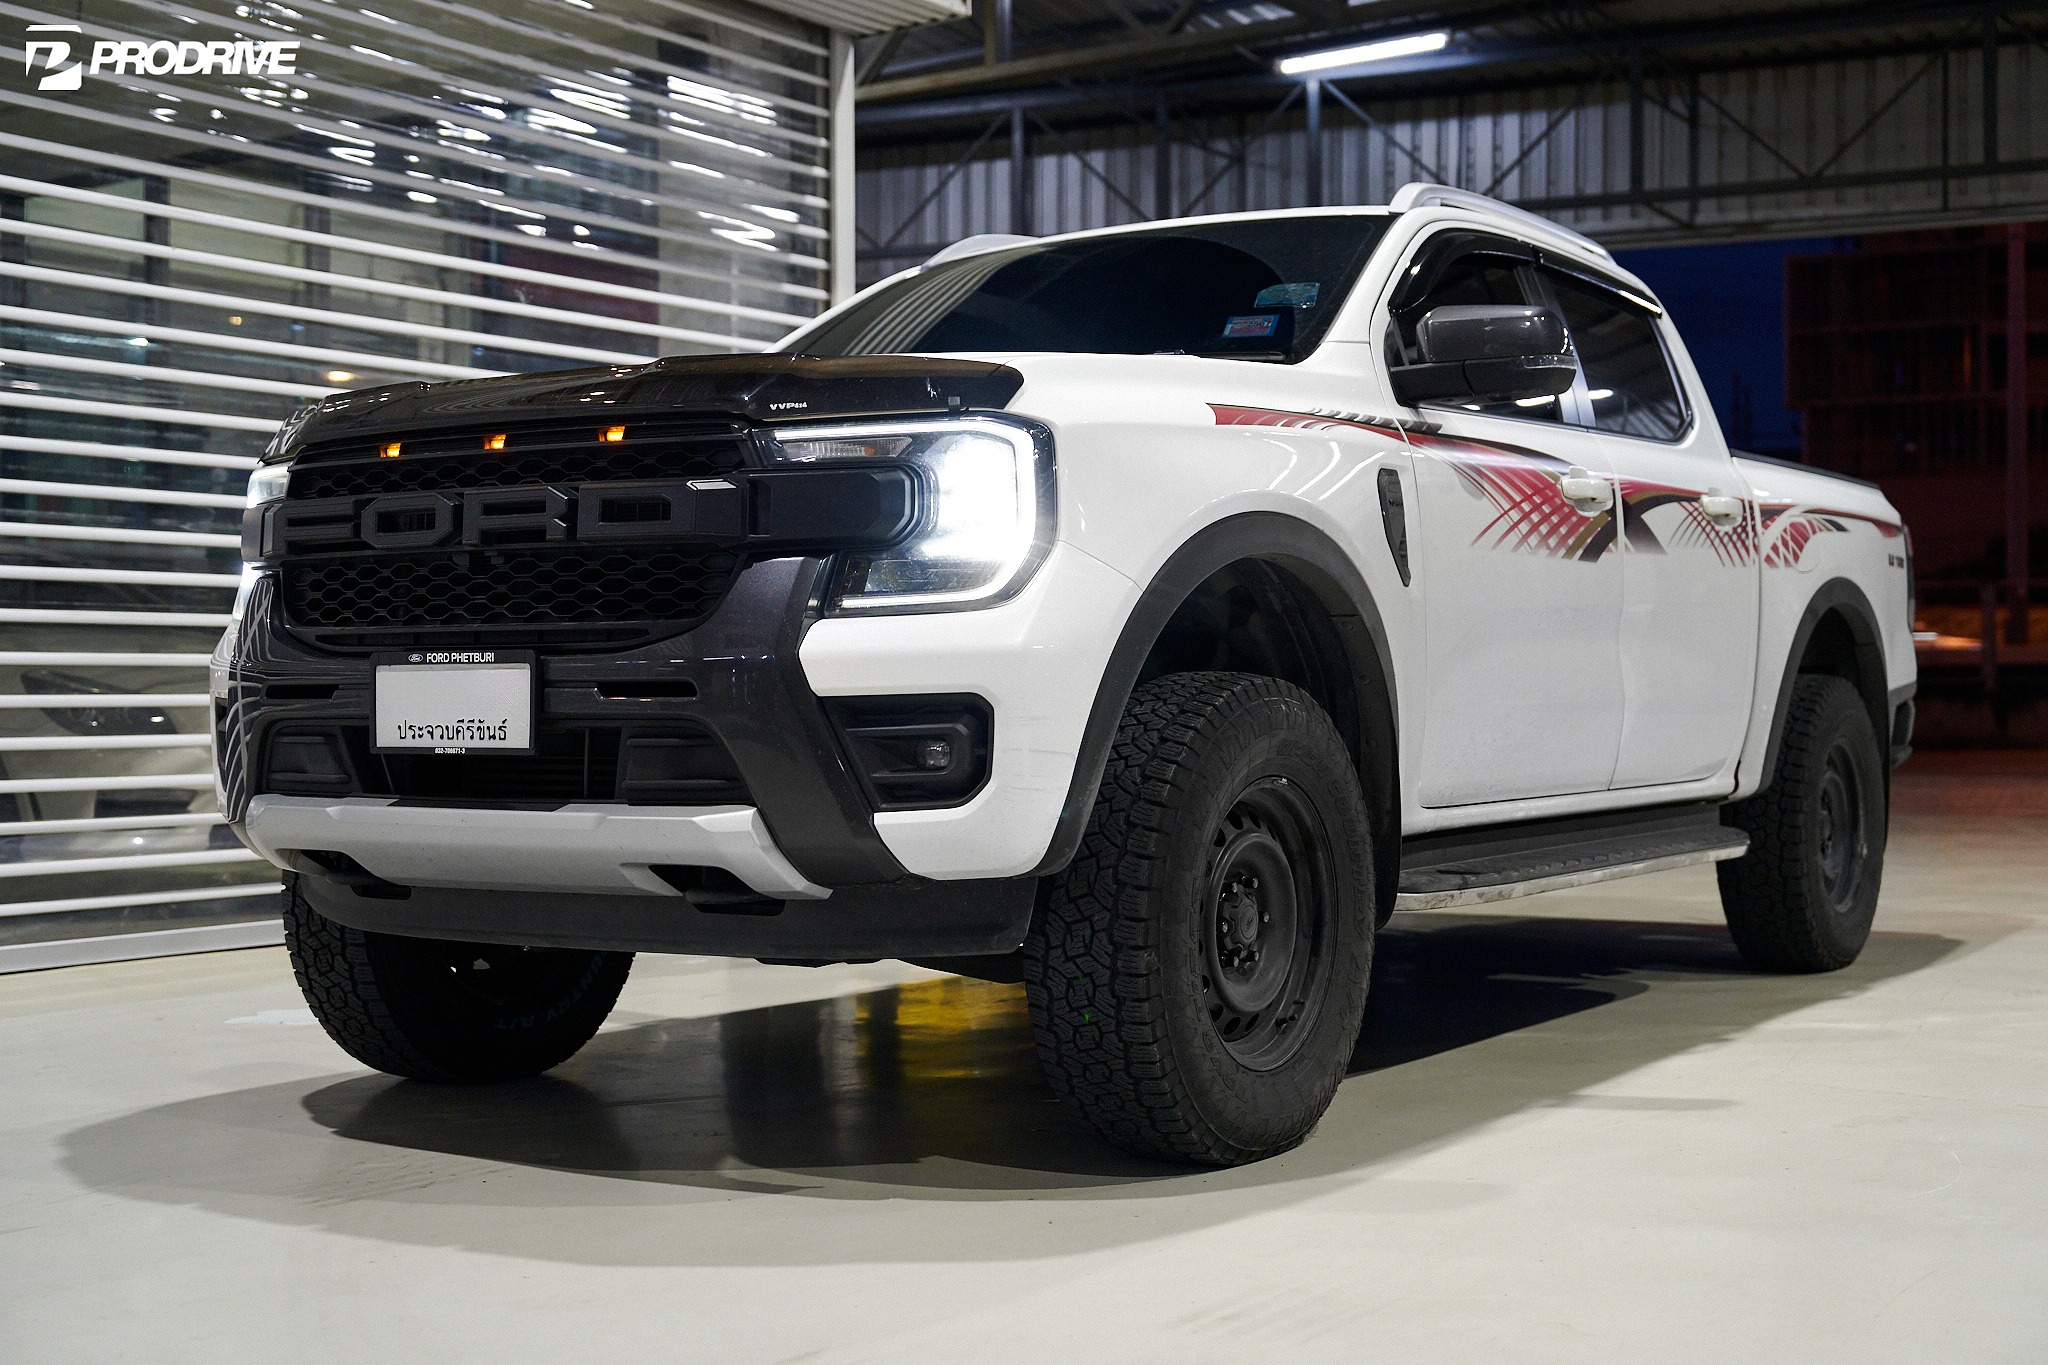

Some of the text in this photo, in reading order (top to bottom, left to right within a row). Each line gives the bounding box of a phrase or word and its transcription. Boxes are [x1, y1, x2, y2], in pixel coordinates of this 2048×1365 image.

[263, 479, 737, 557] FORD
[426, 652, 450, 663] FORD
[451, 652, 495, 663] PHETBURI
[398, 718, 508, 741] ประจวบคีรีขันธ์
